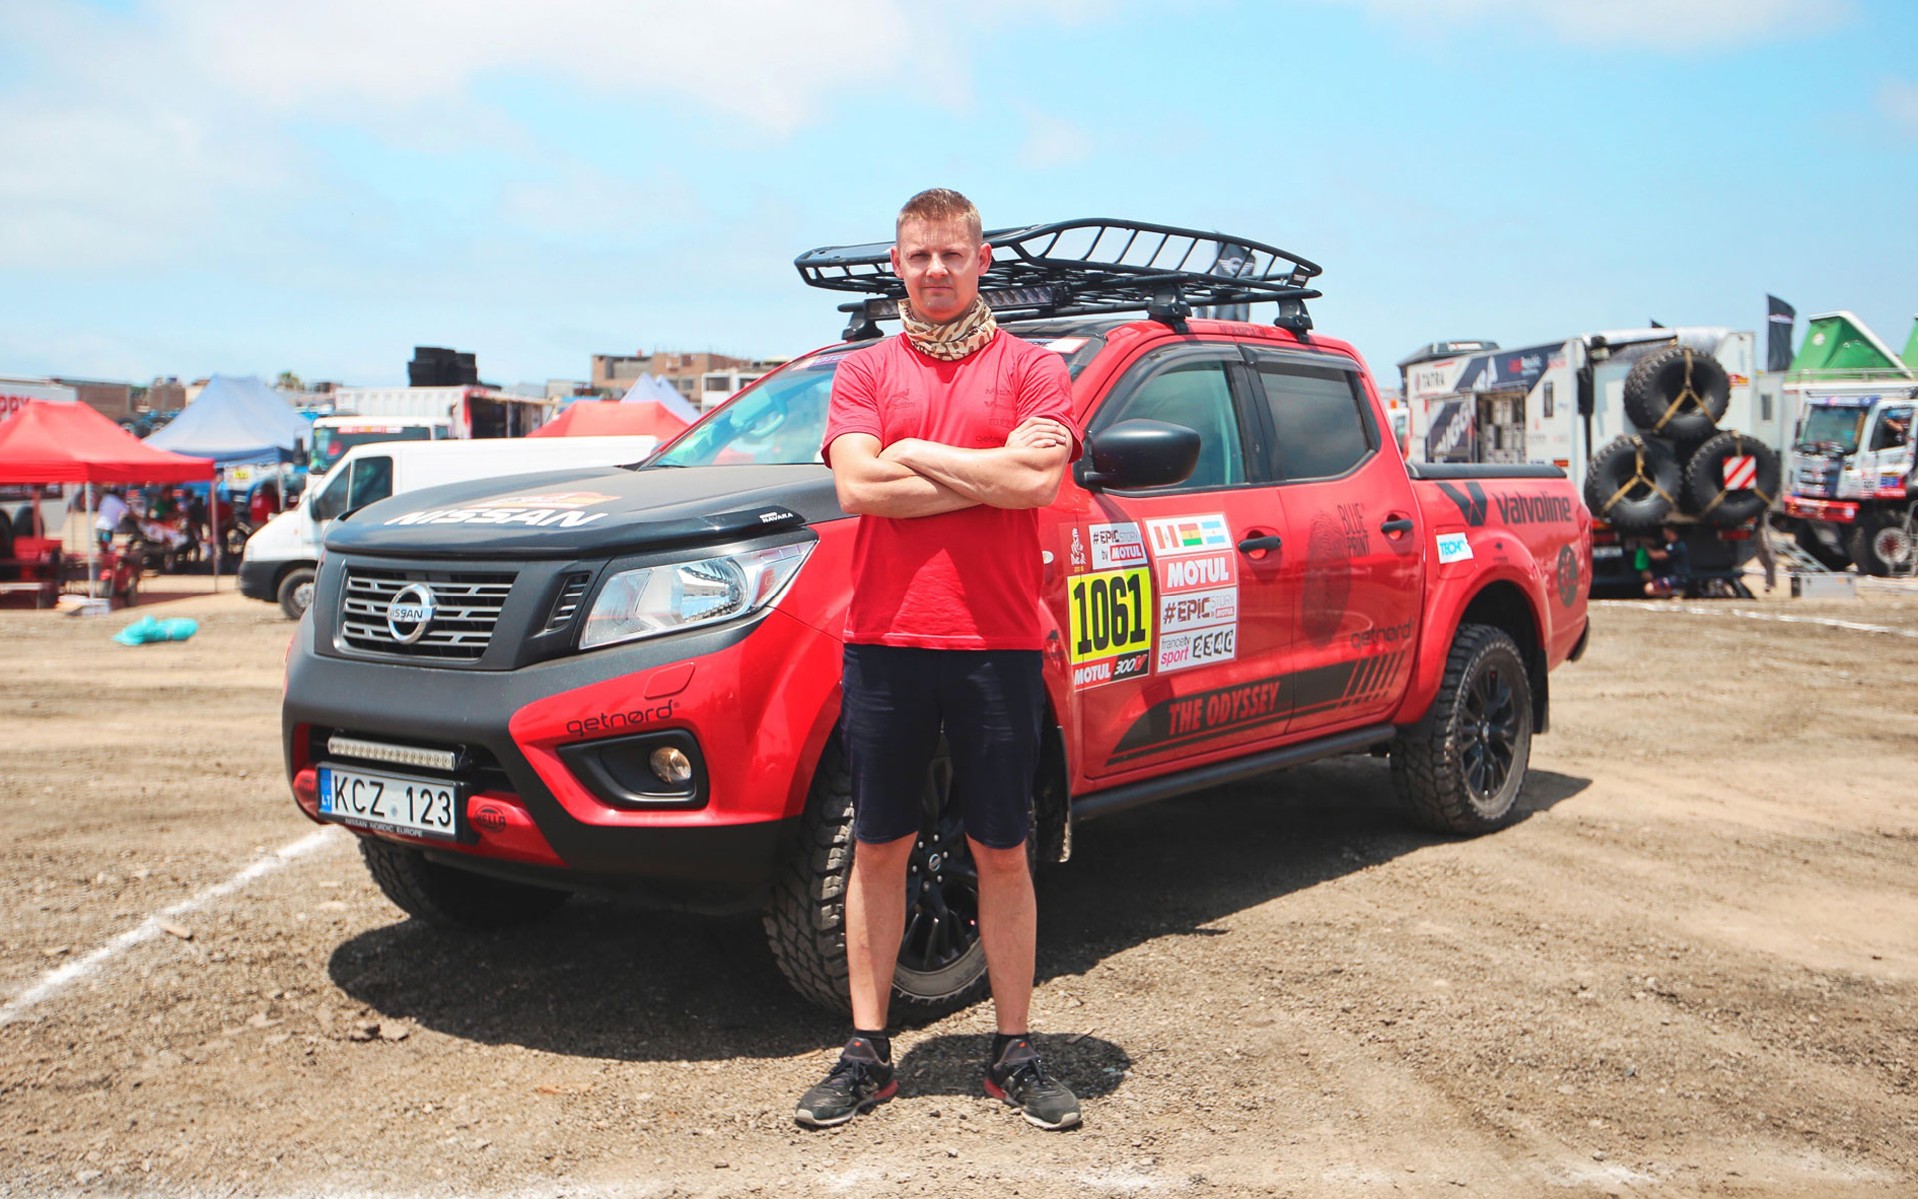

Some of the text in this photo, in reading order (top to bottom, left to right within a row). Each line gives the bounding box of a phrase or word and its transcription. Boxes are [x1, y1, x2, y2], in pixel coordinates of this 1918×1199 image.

[384, 508, 609, 528] NISSAN
[1492, 490, 1572, 525] Valvoline
[1112, 545, 1142, 560] MOTUL
[1167, 557, 1230, 588] MOTUL
[1073, 573, 1146, 656] 1061
[1074, 653, 1148, 686] MOTUL 300V
[1161, 647, 1189, 667] sport
[1169, 681, 1280, 736] THE ODYSSEY
[321, 794, 332, 807] LT
[334, 774, 451, 827] KCZ 123
[345, 818, 423, 837] NISSAN NORDIC EUROPE
